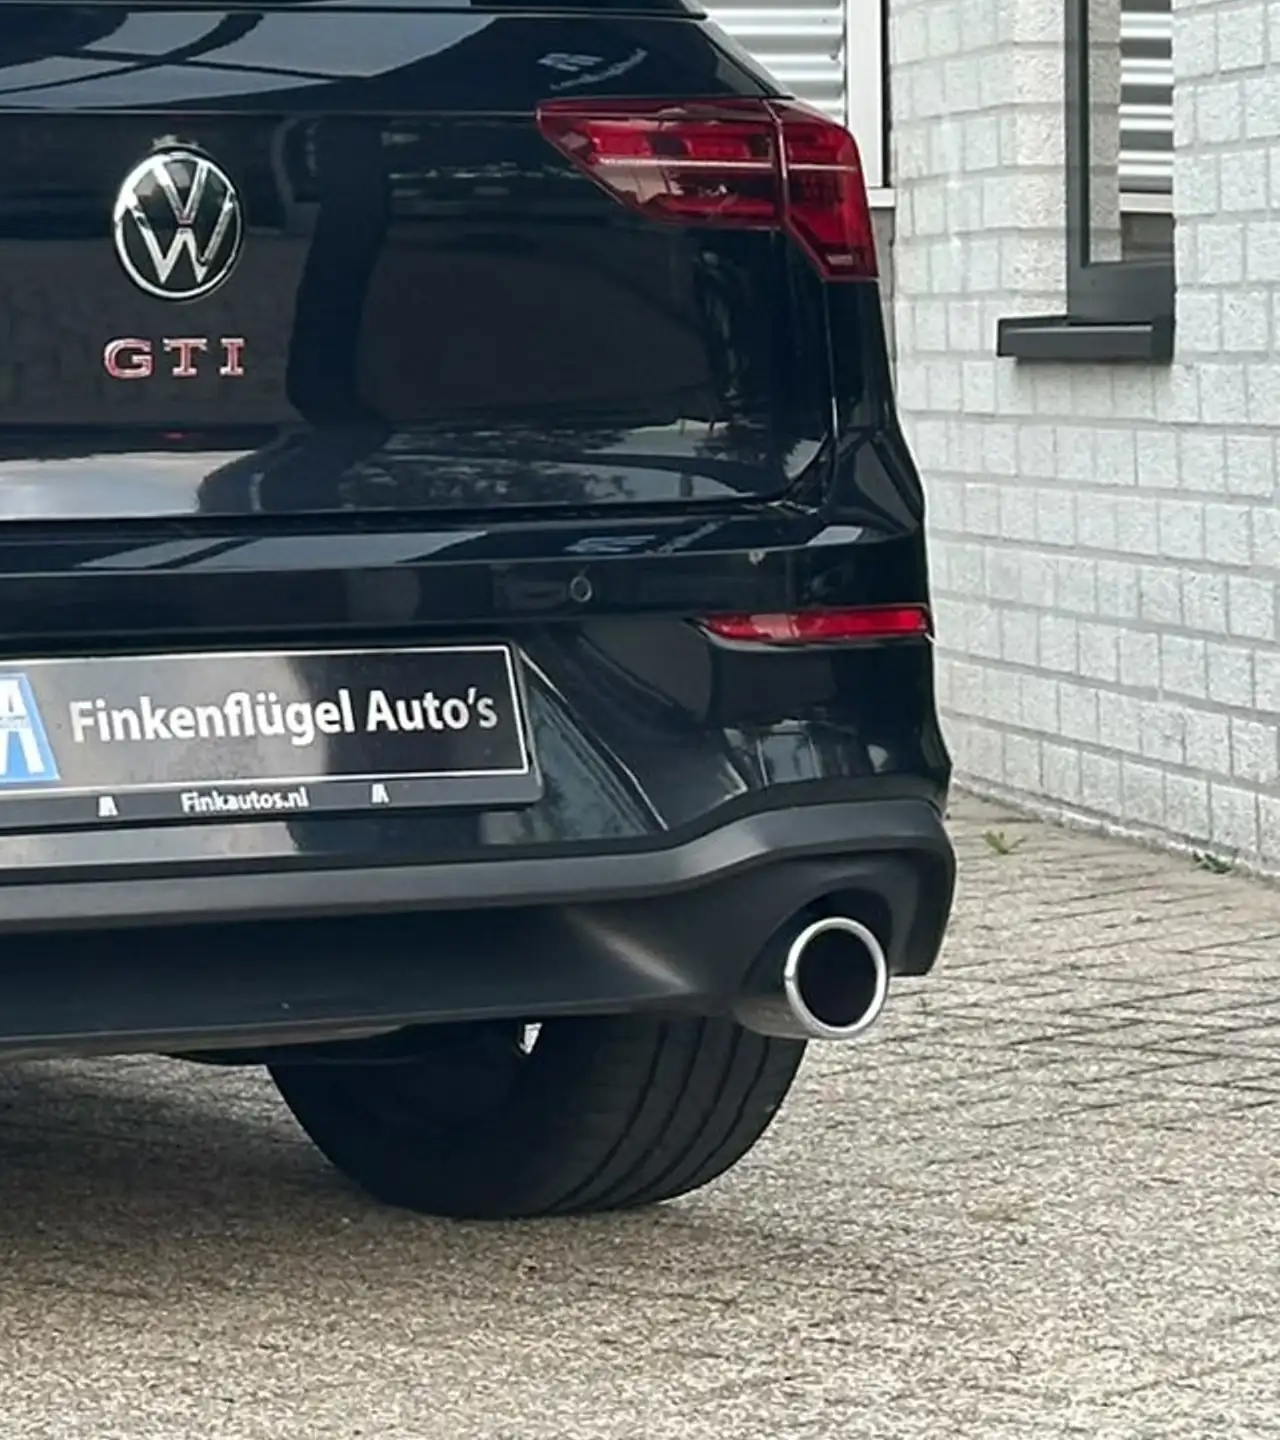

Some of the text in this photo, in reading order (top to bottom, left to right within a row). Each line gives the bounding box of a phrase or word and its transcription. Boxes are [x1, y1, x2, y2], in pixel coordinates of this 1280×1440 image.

[103, 336, 247, 380] GTI
[68, 689, 355, 747] Finkenflügel
[180, 785, 310, 815] Finkautos.nl
